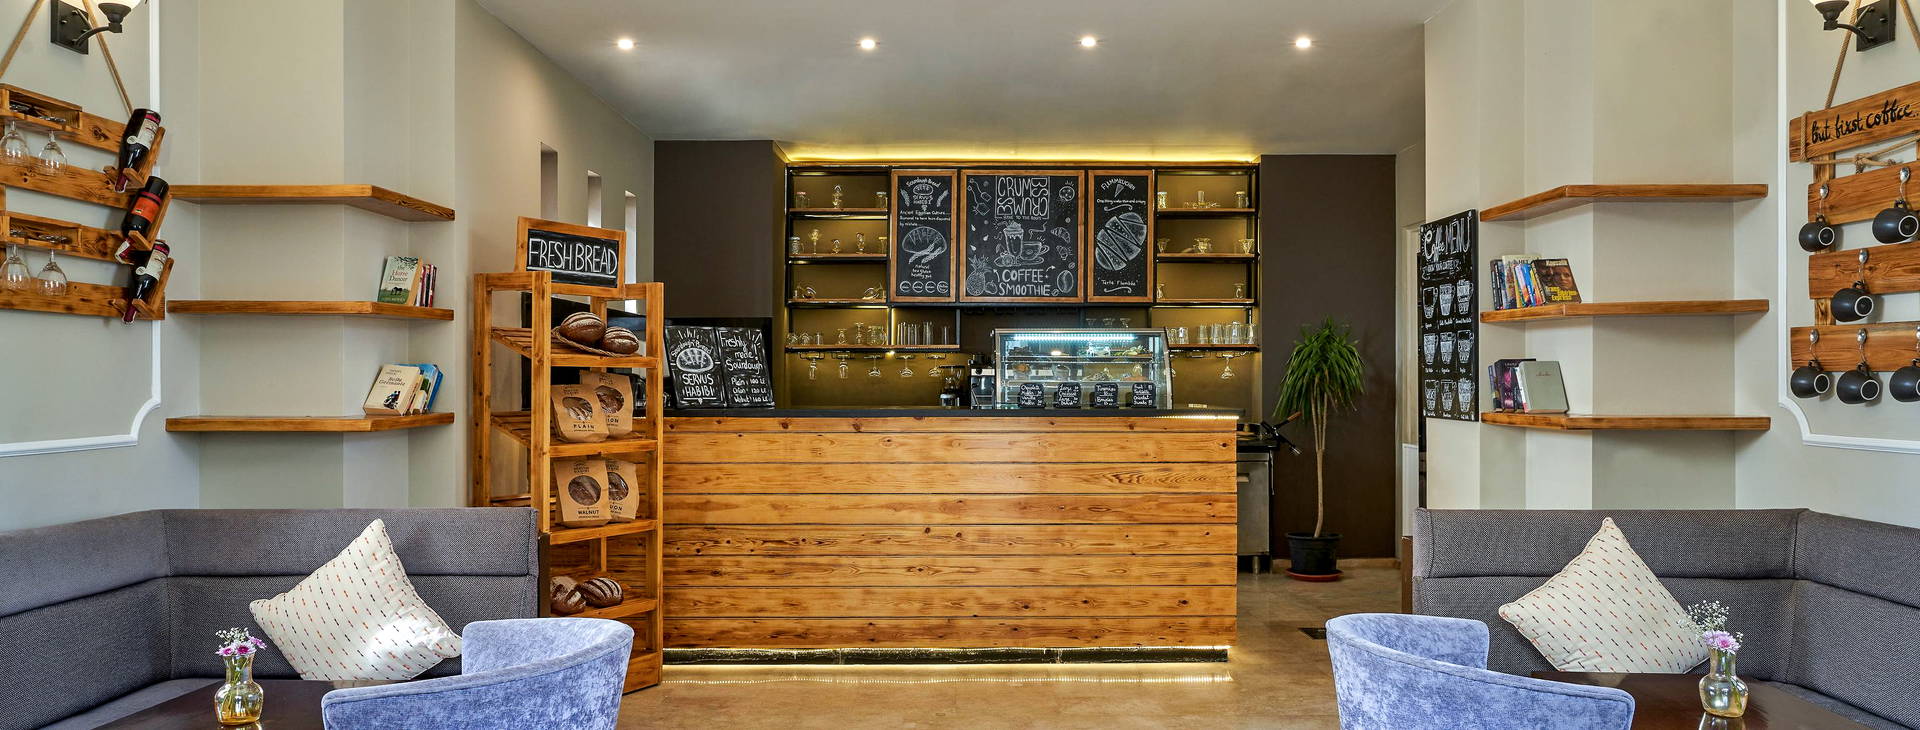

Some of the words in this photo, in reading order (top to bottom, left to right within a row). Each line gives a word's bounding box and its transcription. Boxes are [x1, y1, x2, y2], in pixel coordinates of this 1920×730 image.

[1424, 225, 1445, 262] Coffee
[1445, 216, 1472, 255] MENU
[528, 237, 572, 270] FRESH
[575, 242, 618, 275] BREAD
[1002, 269, 1043, 283] COFFEE
[998, 282, 1051, 296] SMOOTHIE
[719, 330, 747, 352] Freshly
[725, 359, 763, 375] Sourdough
[682, 373, 714, 385] SERVUS
[684, 385, 714, 397] HABIBI
